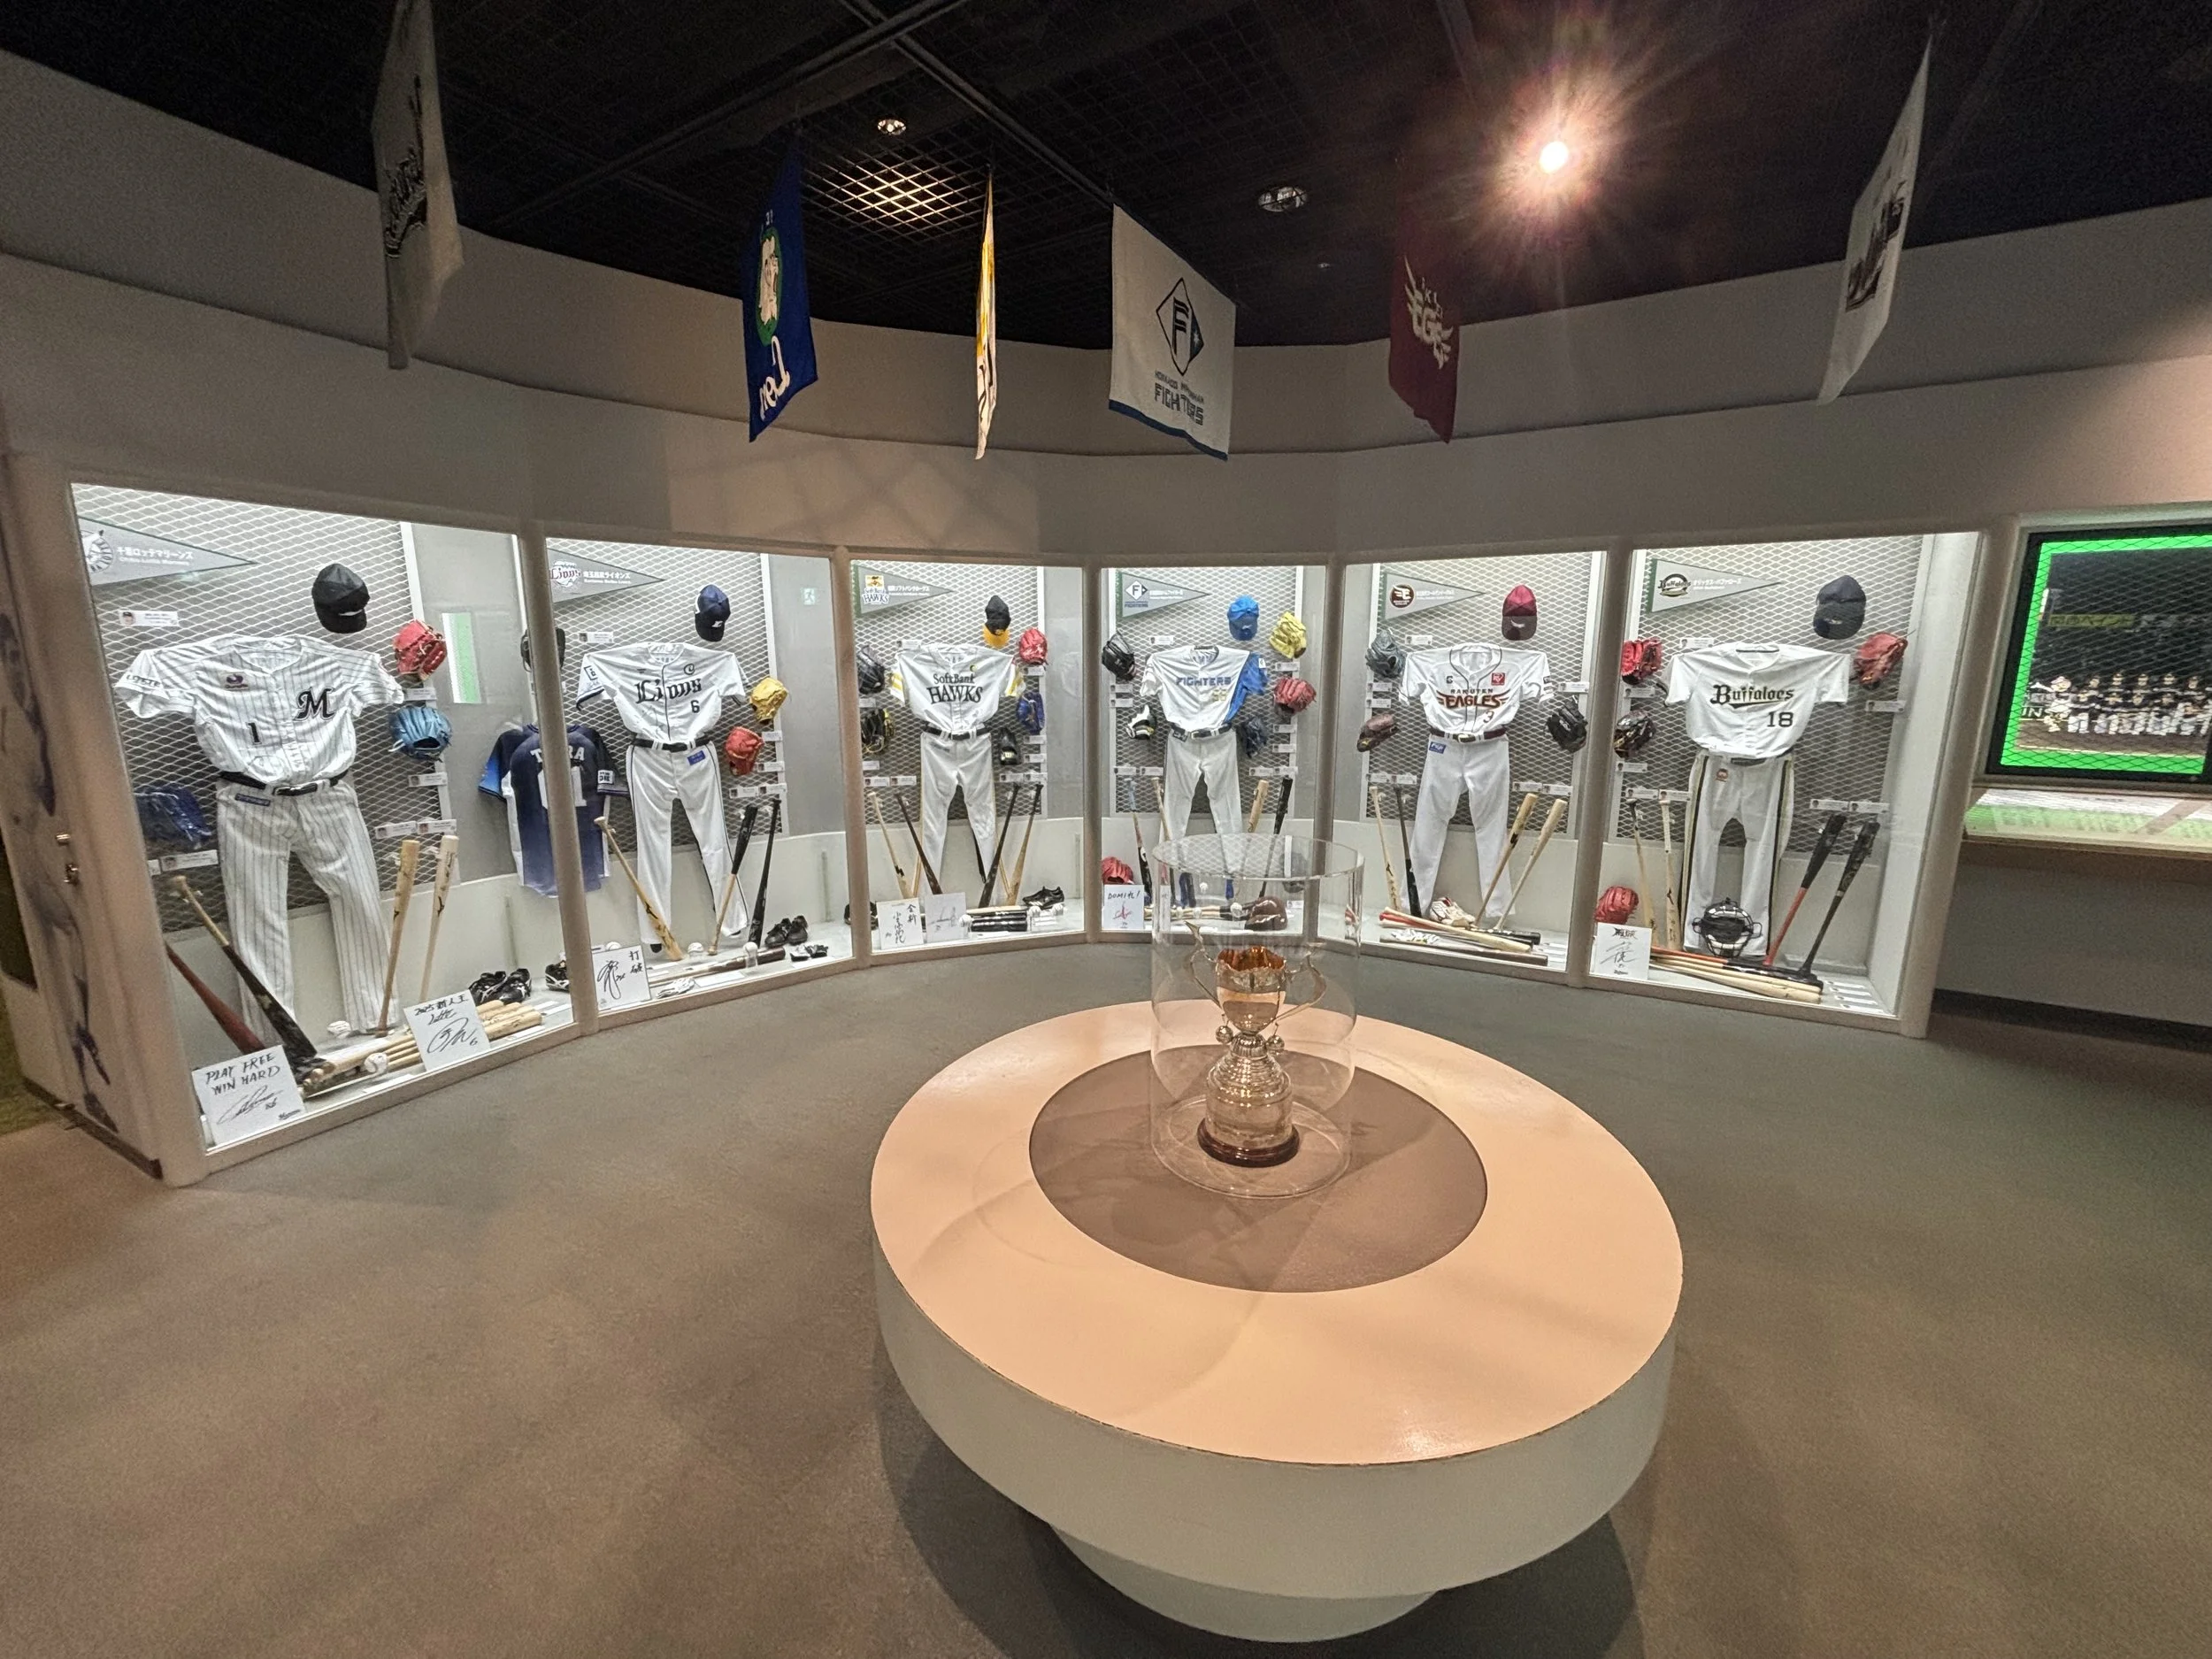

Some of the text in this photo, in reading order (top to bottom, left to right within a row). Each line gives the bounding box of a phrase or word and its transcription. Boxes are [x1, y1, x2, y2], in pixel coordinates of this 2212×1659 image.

[933, 672, 975, 685] SoftBank
[1176, 676, 1232, 686] FIGHTERS
[634, 678, 702, 704] Lions
[926, 685, 983, 705] HAWKS
[1710, 684, 1795, 706] Buffaloes
[293, 687, 335, 722] M
[690, 700, 700, 713] 6
[1444, 695, 1502, 709] EAGLES
[1483, 710, 1495, 724] 3
[1767, 710, 1794, 727] 18
[248, 721, 263, 746] 1
[205, 1052, 275, 1085] PLAY FREE
[211, 1064, 280, 1096] WIN HARD
